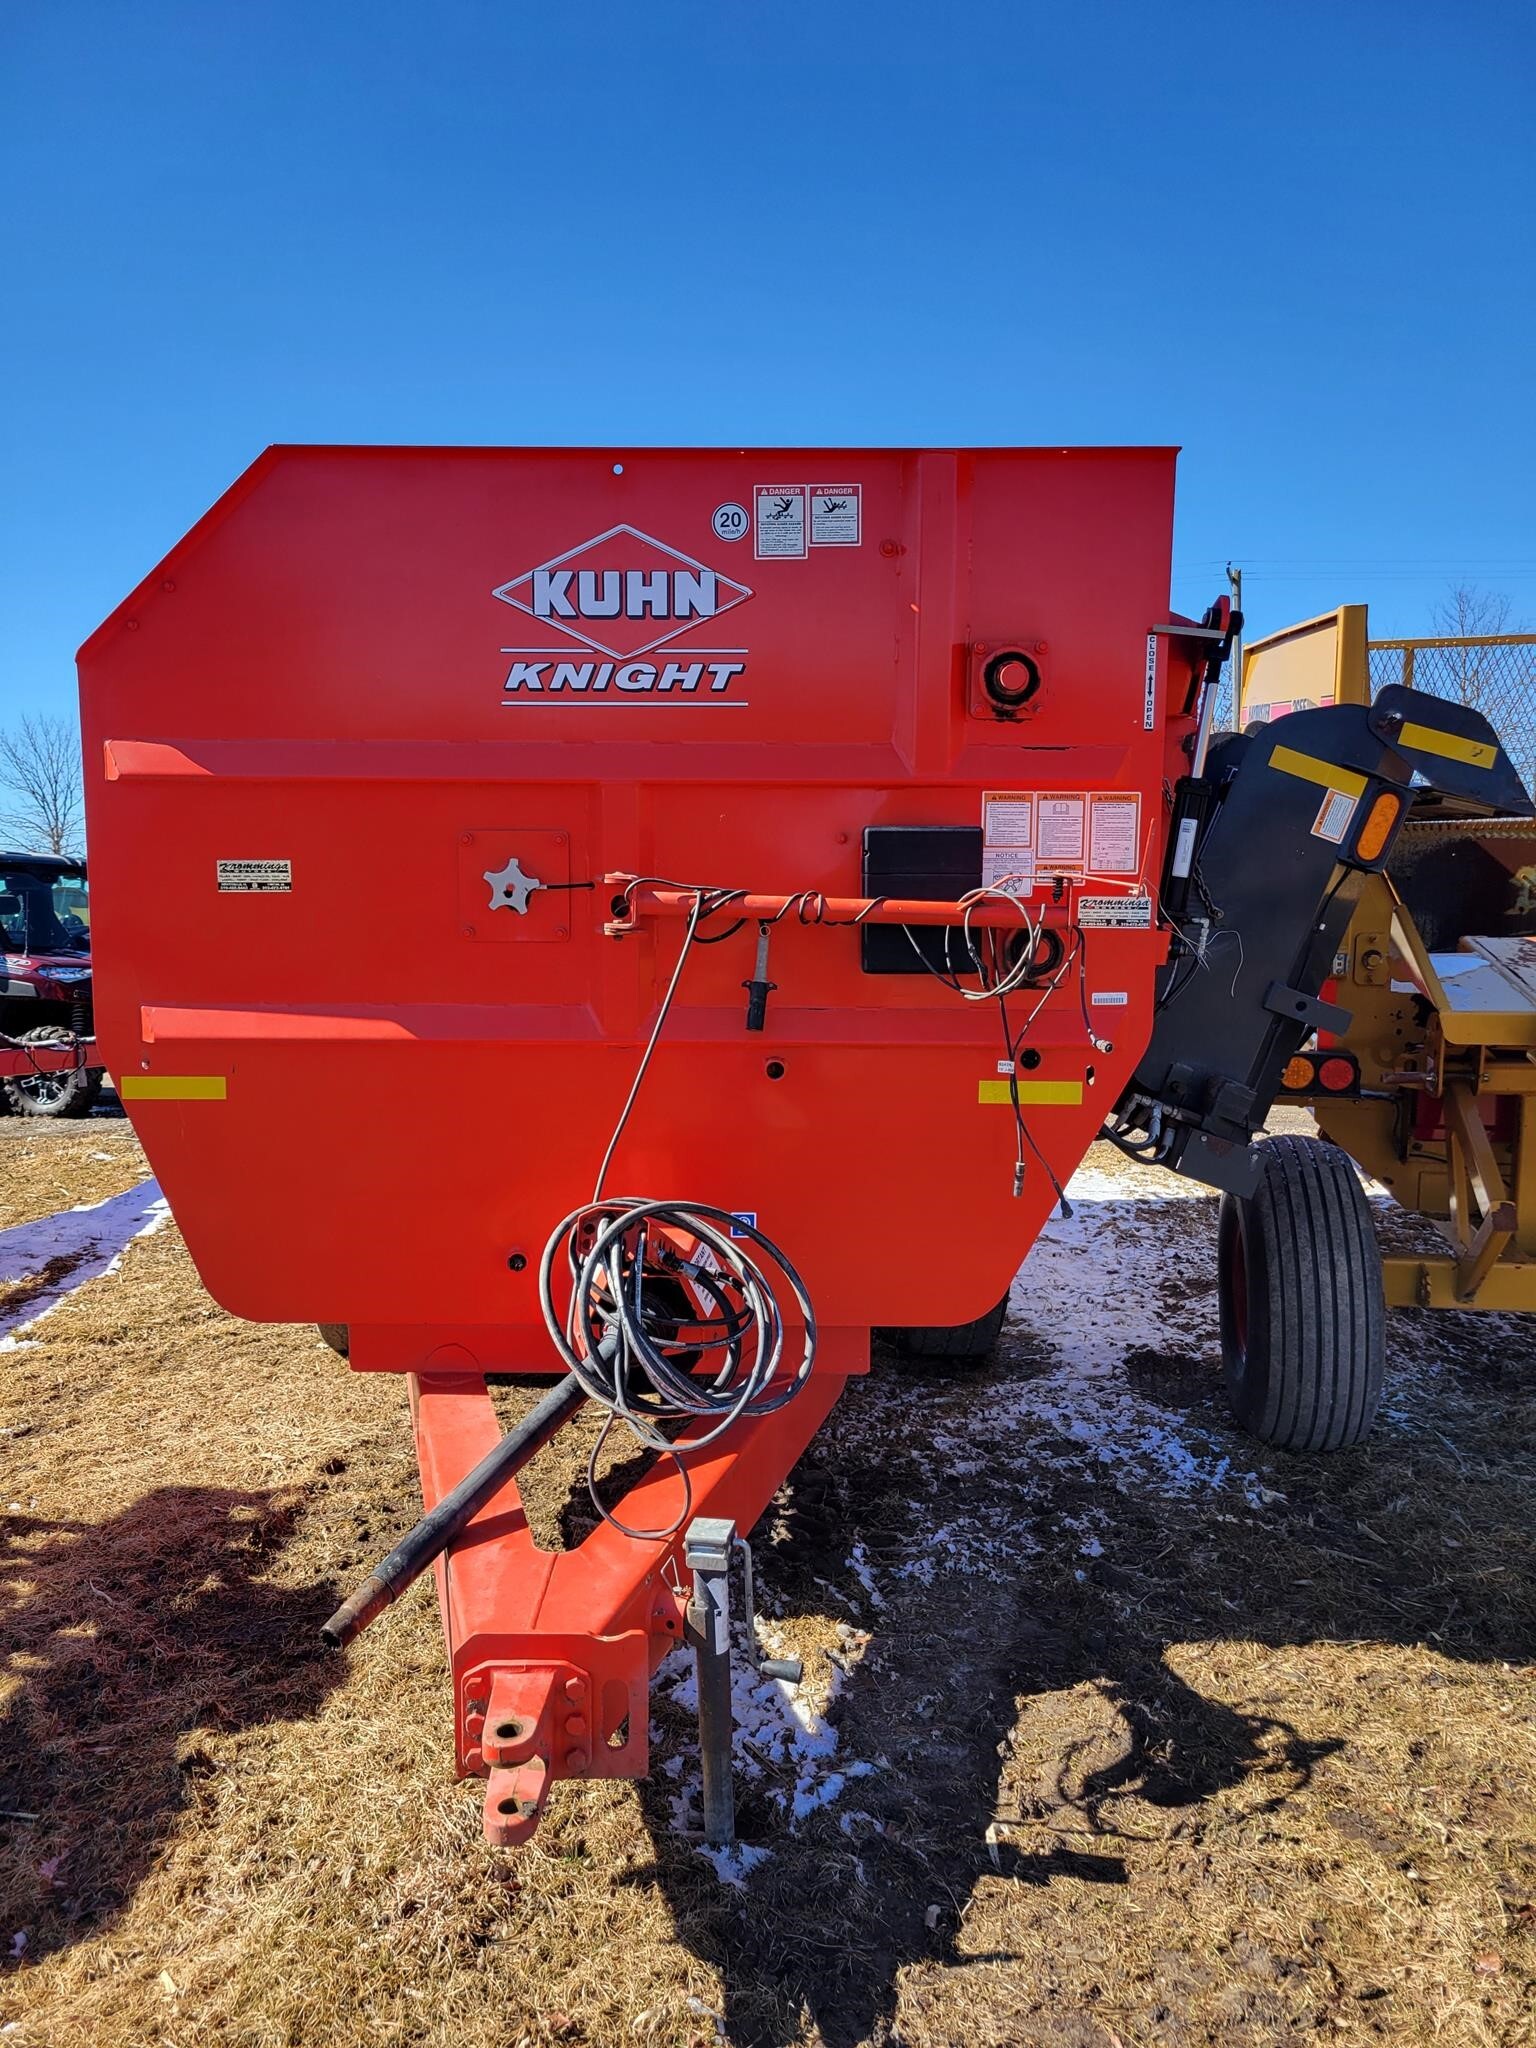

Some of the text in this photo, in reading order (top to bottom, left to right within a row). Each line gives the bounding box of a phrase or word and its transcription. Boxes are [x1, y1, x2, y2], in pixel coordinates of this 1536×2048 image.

[719, 512, 742, 528] 20
[532, 570, 718, 619] KUHN
[1148, 636, 1156, 672] CLOSE
[503, 662, 746, 692] KNIGHT
[1145, 700, 1153, 728] OPEN
[1050, 793, 1080, 801] WARNING
[1080, 899, 1149, 909] Kromminga
